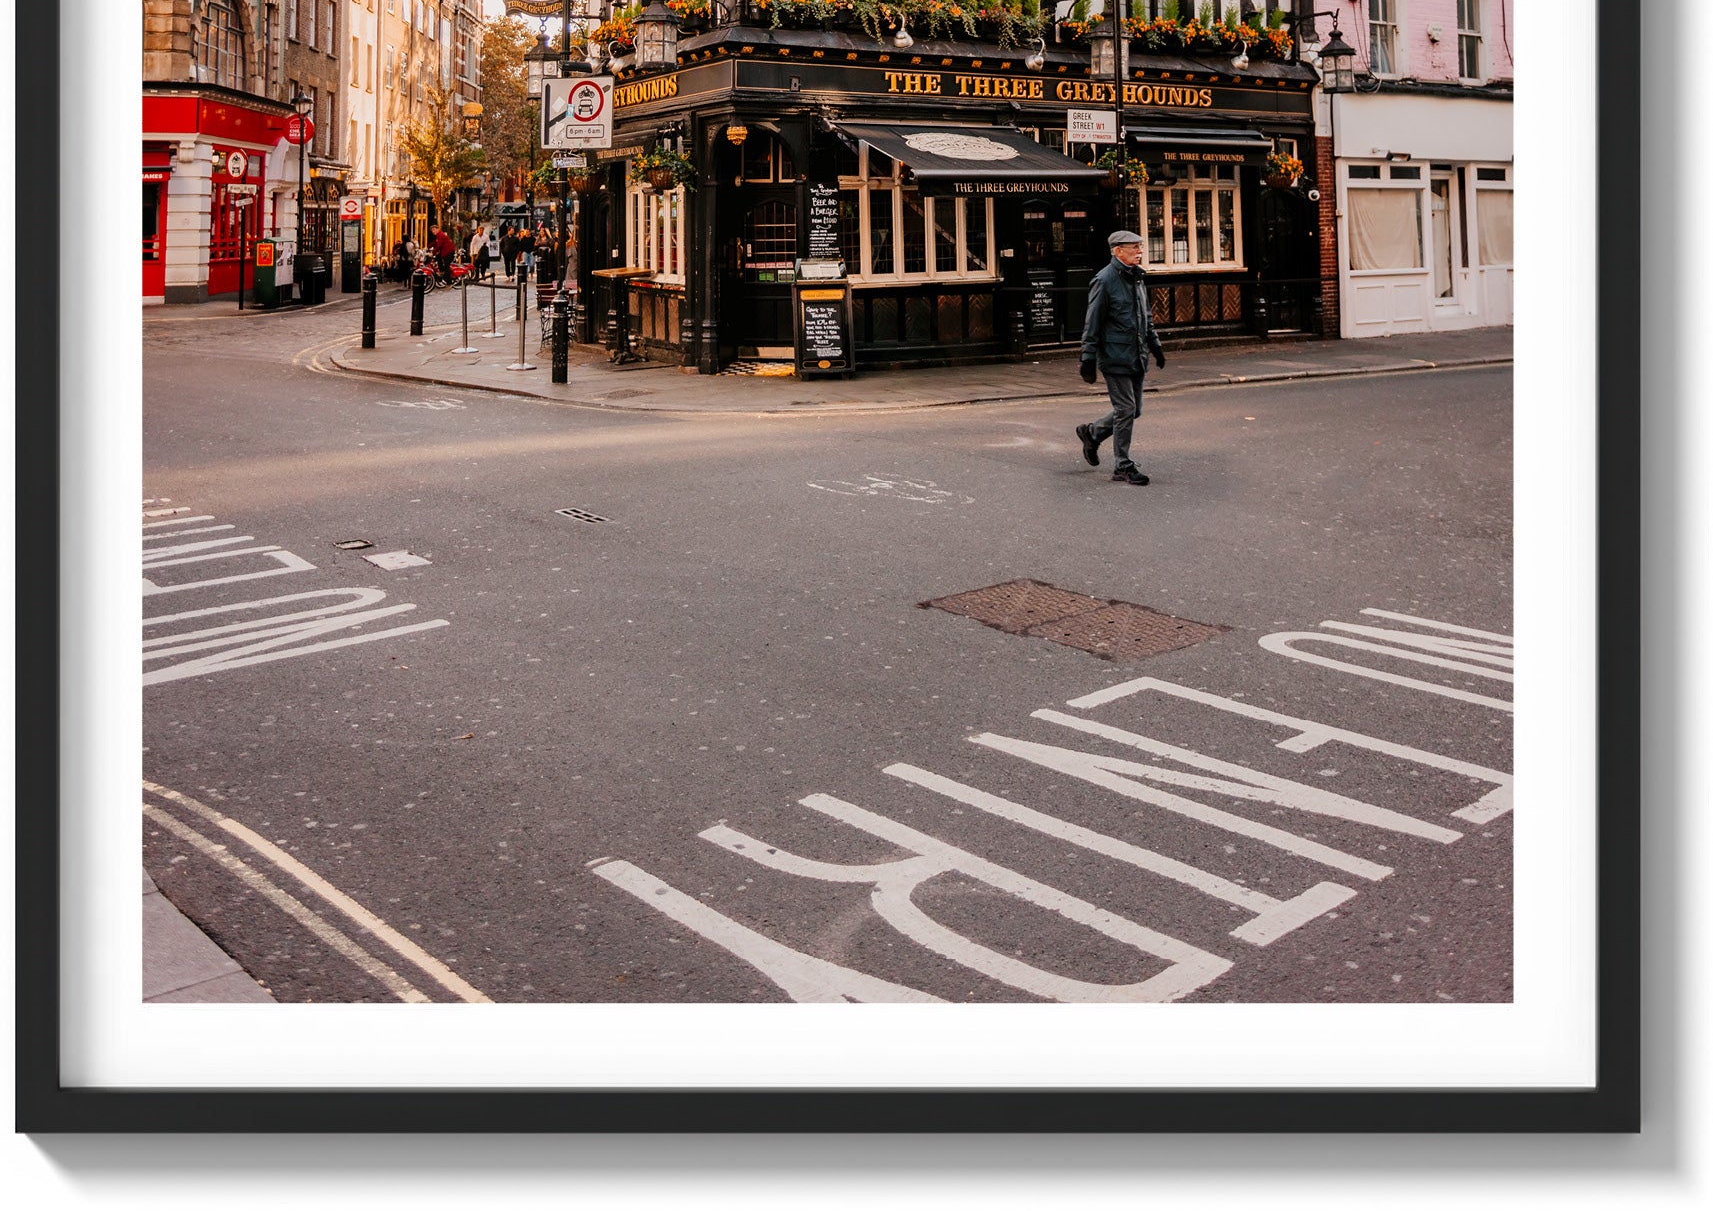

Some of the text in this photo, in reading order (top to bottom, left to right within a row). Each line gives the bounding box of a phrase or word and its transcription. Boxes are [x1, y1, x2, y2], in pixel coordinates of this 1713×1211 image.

[507, 0, 528, 11] THREE
[613, 74, 677, 107] EYHOUNDS
[885, 71, 1213, 108] THE THREE GREYHOUNDS
[1073, 112, 1091, 120] GREEK
[1073, 122, 1093, 130] STREET
[1163, 152, 1245, 163] THE THREE GREYHOUNDS
[953, 182, 1069, 193] THE THREE GREYHOUNDS
